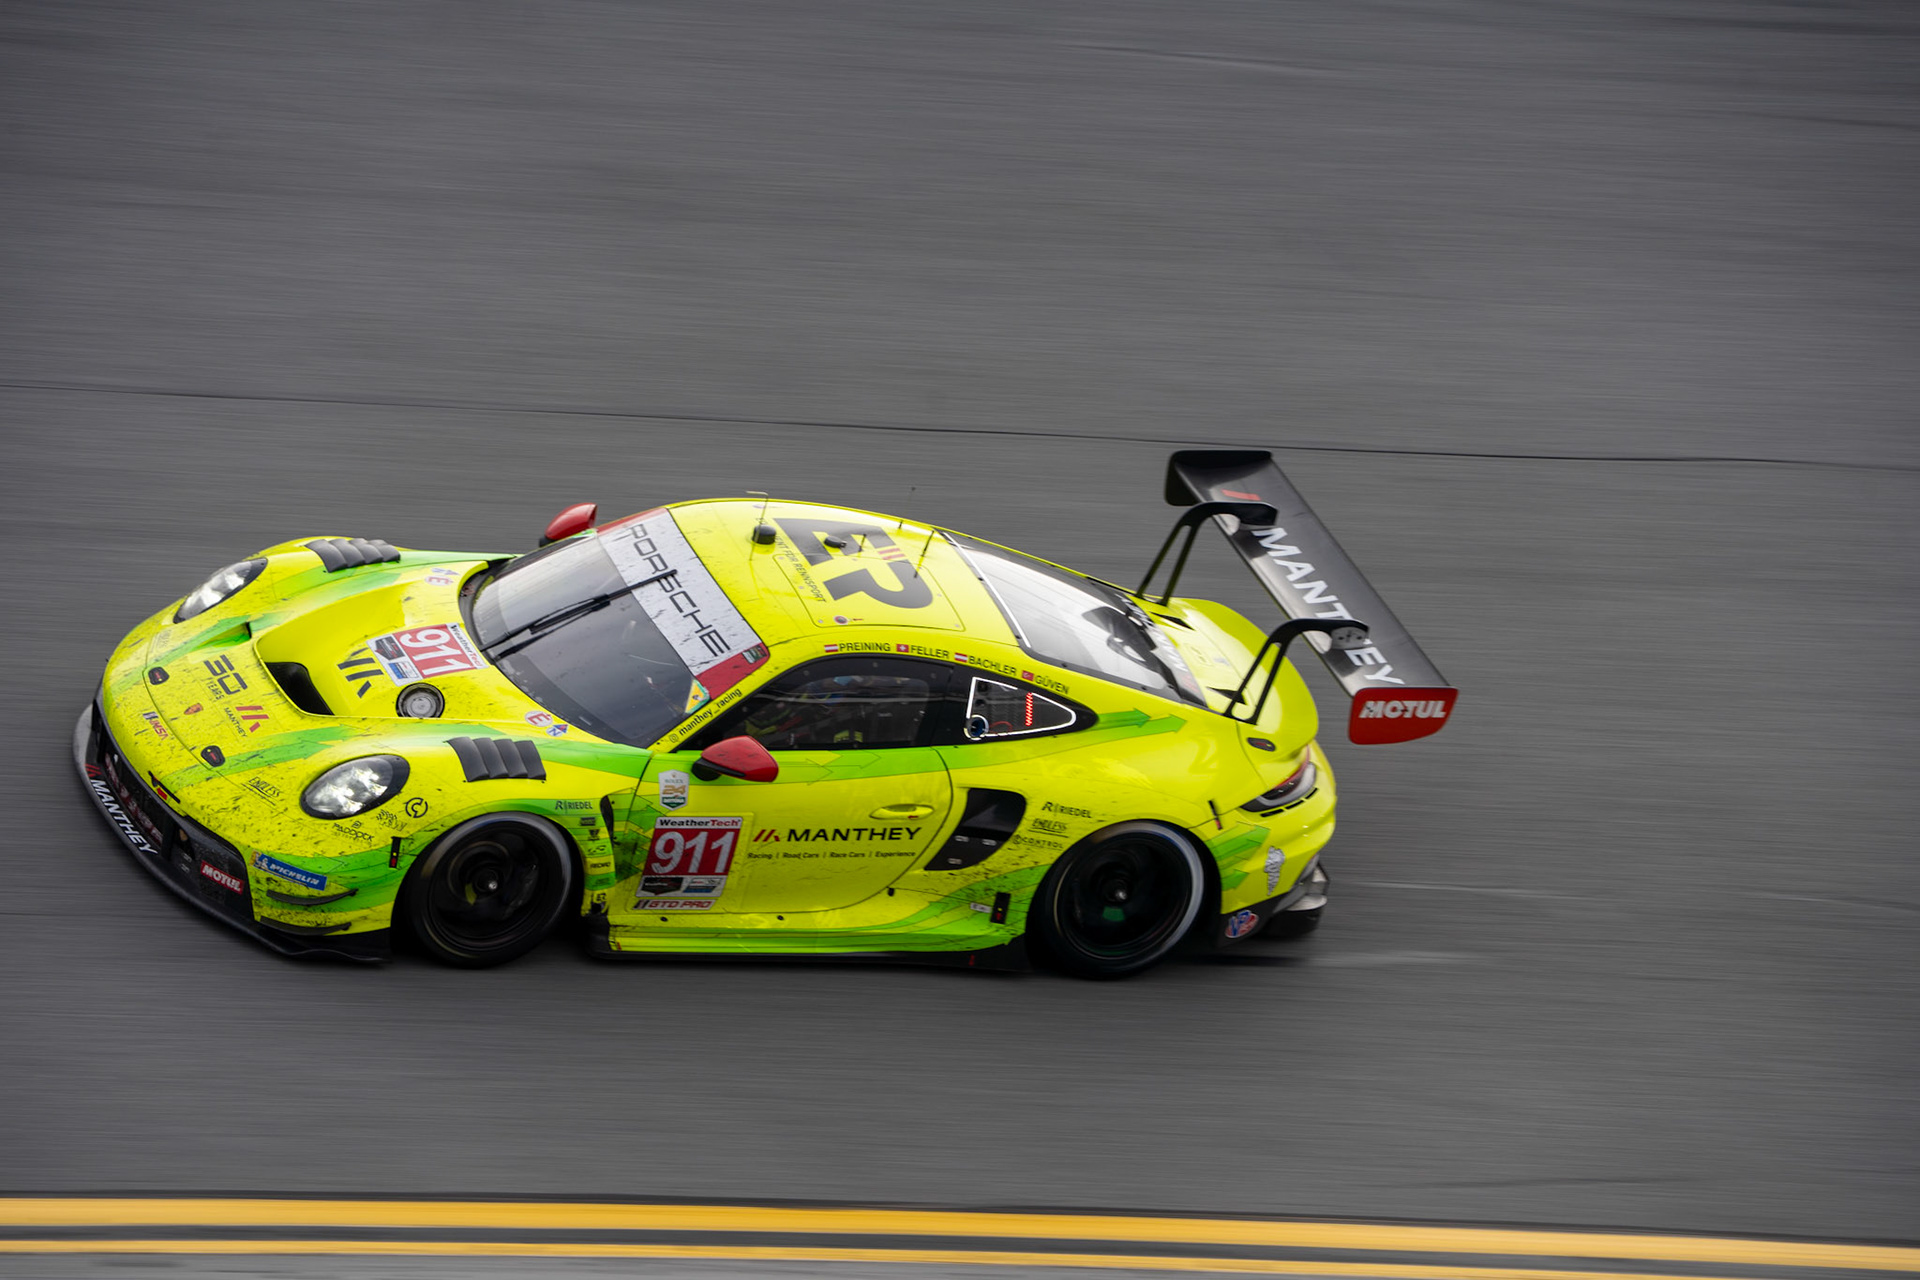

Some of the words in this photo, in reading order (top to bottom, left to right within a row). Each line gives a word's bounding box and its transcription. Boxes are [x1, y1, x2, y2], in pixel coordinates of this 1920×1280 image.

[623, 523, 731, 657] PORSCHE
[1251, 527, 1405, 685] MANTEY
[400, 628, 471, 676] 911
[839, 642, 891, 652] PREINING
[910, 645, 949, 660] FELLER
[968, 655, 1017, 676] BACHLER
[1034, 674, 1069, 694] GÜVEN
[679, 688, 742, 736] manthey_racing
[1358, 700, 1446, 719] MOTUL
[224, 707, 248, 738] MANTHEY
[662, 784, 686, 795] 24
[567, 801, 593, 810] RIEDEL
[1059, 805, 1092, 819] RIEDEL
[90, 778, 158, 855] MANTHEY
[660, 819, 738, 827] WeatherTech
[1032, 818, 1068, 831] ENDLESS
[332, 822, 375, 842] PADDOCK
[787, 827, 922, 842] MANTHEY
[651, 831, 735, 874] 911
[748, 852, 773, 860] Racing
[201, 863, 242, 892] MOTUL
[269, 863, 321, 886] MICHELIN
